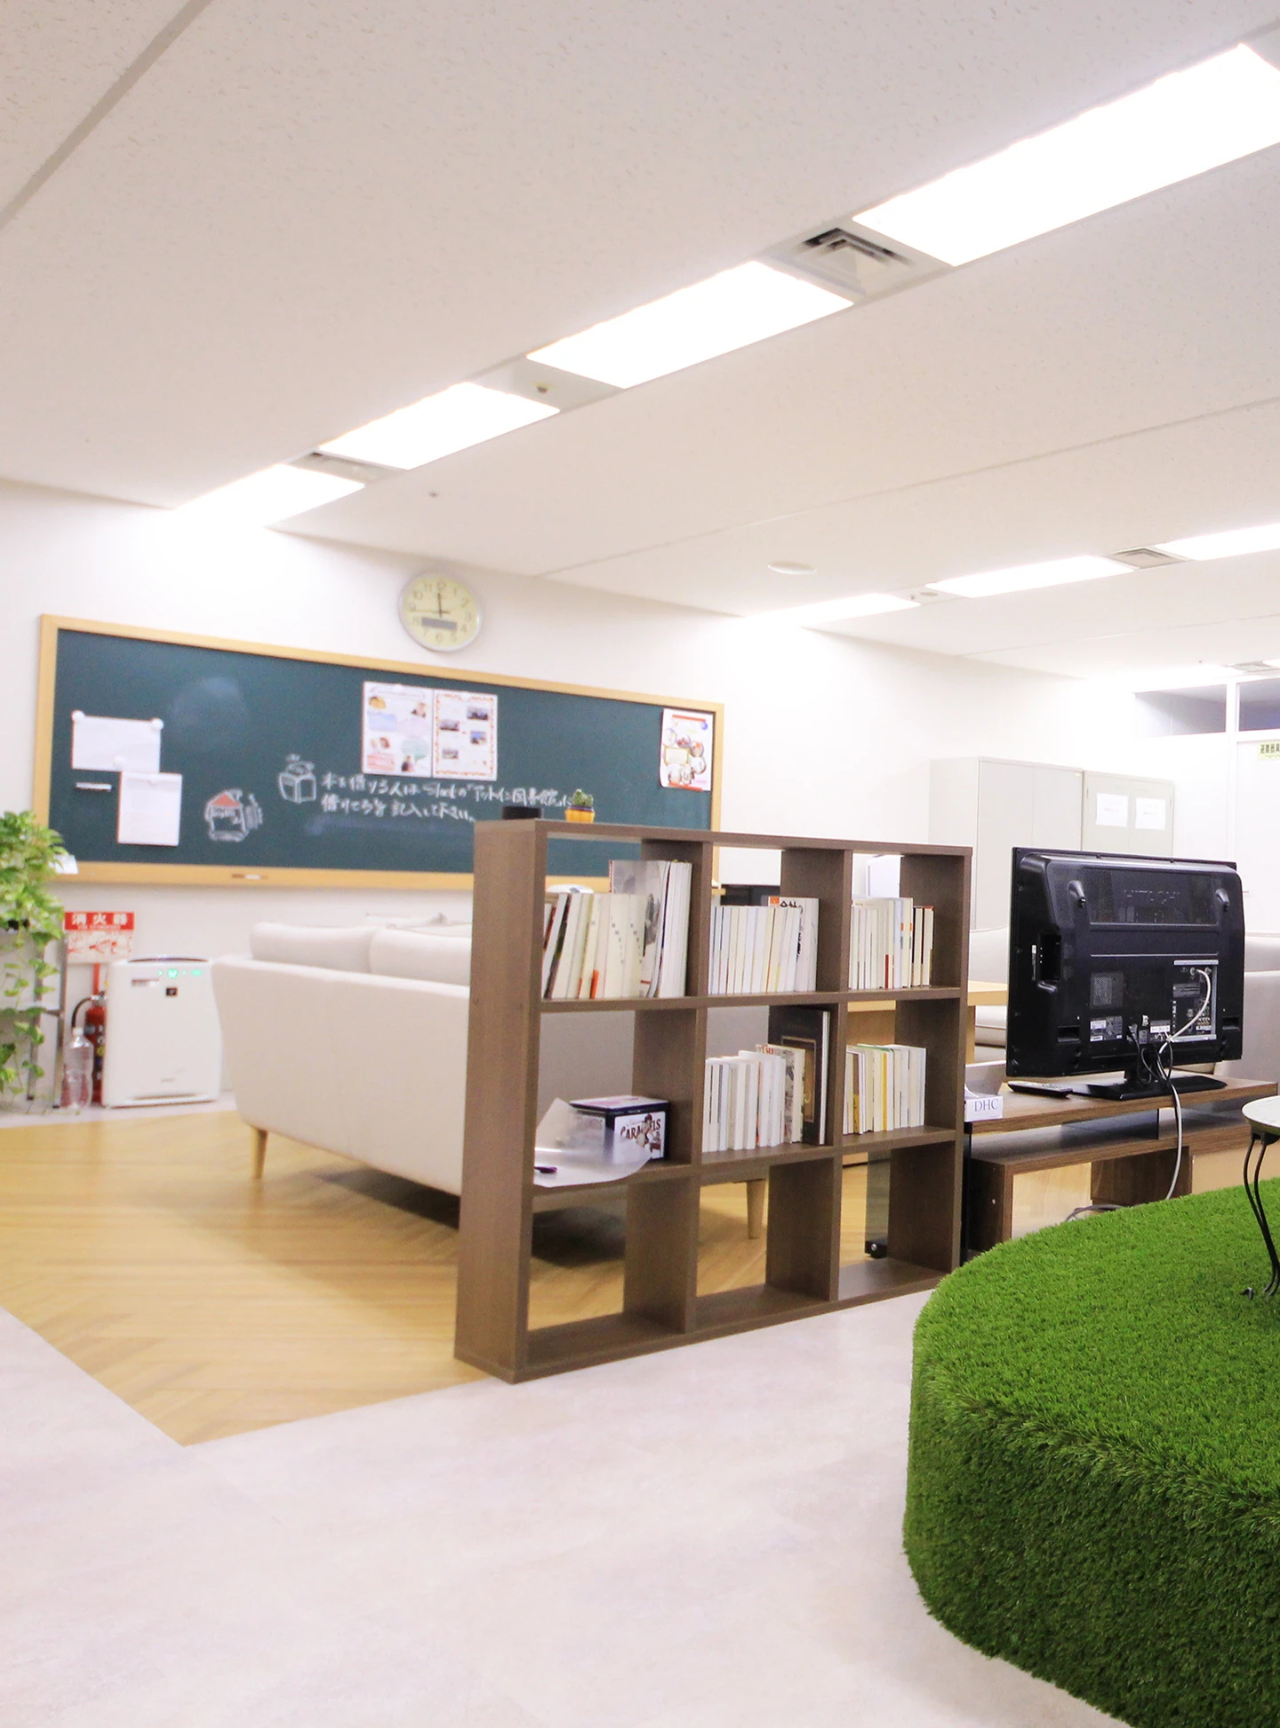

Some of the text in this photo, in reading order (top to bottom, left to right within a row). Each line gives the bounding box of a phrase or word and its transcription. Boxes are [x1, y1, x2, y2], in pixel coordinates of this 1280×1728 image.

[71, 913, 128, 926] 消火器
[974, 1098, 999, 1112] DHC
